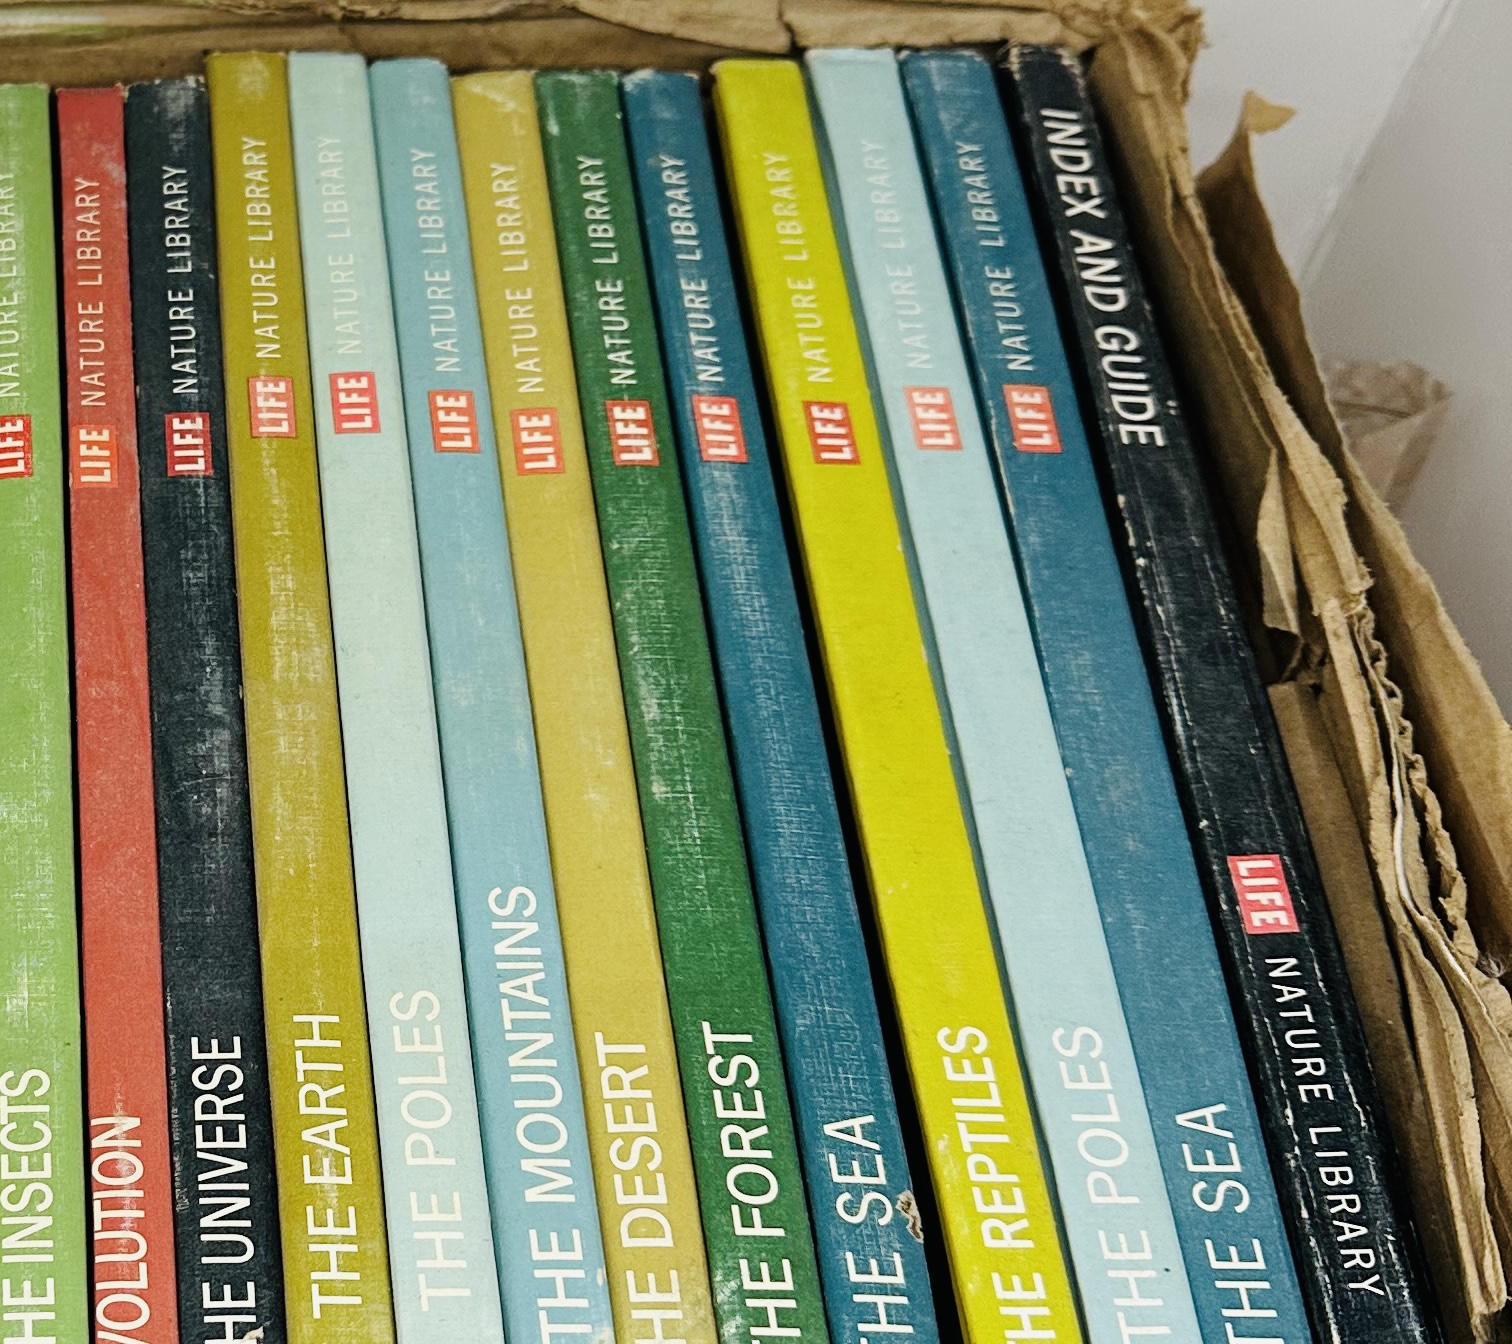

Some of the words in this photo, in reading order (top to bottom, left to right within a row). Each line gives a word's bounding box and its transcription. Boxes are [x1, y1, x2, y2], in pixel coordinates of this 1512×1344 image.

[242, 137, 273, 242] LIBRARY
[315, 134, 349, 239] LIBRARY
[410, 148, 446, 255] LIBRARY
[491, 162, 531, 273] LIBRARY
[578, 156, 617, 265] LIBRARY
[660, 155, 702, 261] LIBRARY
[764, 153, 809, 261] LIBRARY
[863, 140, 906, 248] LIBRARY
[958, 141, 1006, 247] LIBRARY
[1040, 107, 1106, 221] INDEX
[75, 177, 104, 287] LIBRARY
[162, 165, 192, 273] LIBRARY
[1072, 231, 1124, 313] AND
[77, 300, 107, 407] NATURE
[168, 288, 199, 395] NATURE
[250, 253, 282, 359] NATURE
[329, 252, 361, 355] NATURE
[427, 268, 461, 373] NATURE
[508, 287, 544, 394] NATURE
[600, 278, 636, 385] NATURE
[689, 275, 726, 382] NATURE
[794, 277, 834, 383] NATURE
[889, 263, 930, 370] NATURE
[987, 264, 1034, 371] NATURE
[257, 378, 289, 436] LIFE
[339, 374, 373, 430] LIFE
[437, 394, 472, 450] LIFE
[613, 404, 654, 465] LIFE
[699, 399, 739, 460] LIFE
[812, 402, 852, 462] LIFE
[912, 389, 953, 448] LIFE
[1010, 386, 1054, 451] LIFE
[1094, 325, 1164, 447] GUIDE
[80, 428, 112, 485] LIFE
[172, 414, 206, 474] LIFE
[520, 411, 556, 472] LIFE
[390, 988, 457, 1167] POLES
[488, 885, 577, 1204] MOUNTAINS
[1233, 858, 1290, 928] LIFE
[1265, 956, 1334, 1104] NATURE
[1308, 1125, 1385, 1297] LIBRARY
[191, 1035, 252, 1264] UNIVERSE
[294, 1014, 353, 1186] EARTH
[594, 1032, 673, 1249] DESERT
[702, 1020, 787, 1238] FOREST
[937, 1026, 1036, 1249] REPTILES
[1052, 1026, 1142, 1205] POLES
[0, 1068, 53, 1265] INSECTS
[824, 1114, 894, 1227] SEA
[1176, 1102, 1251, 1214] SEA
[304, 1205, 361, 1318] THE
[410, 1194, 470, 1310] THE
